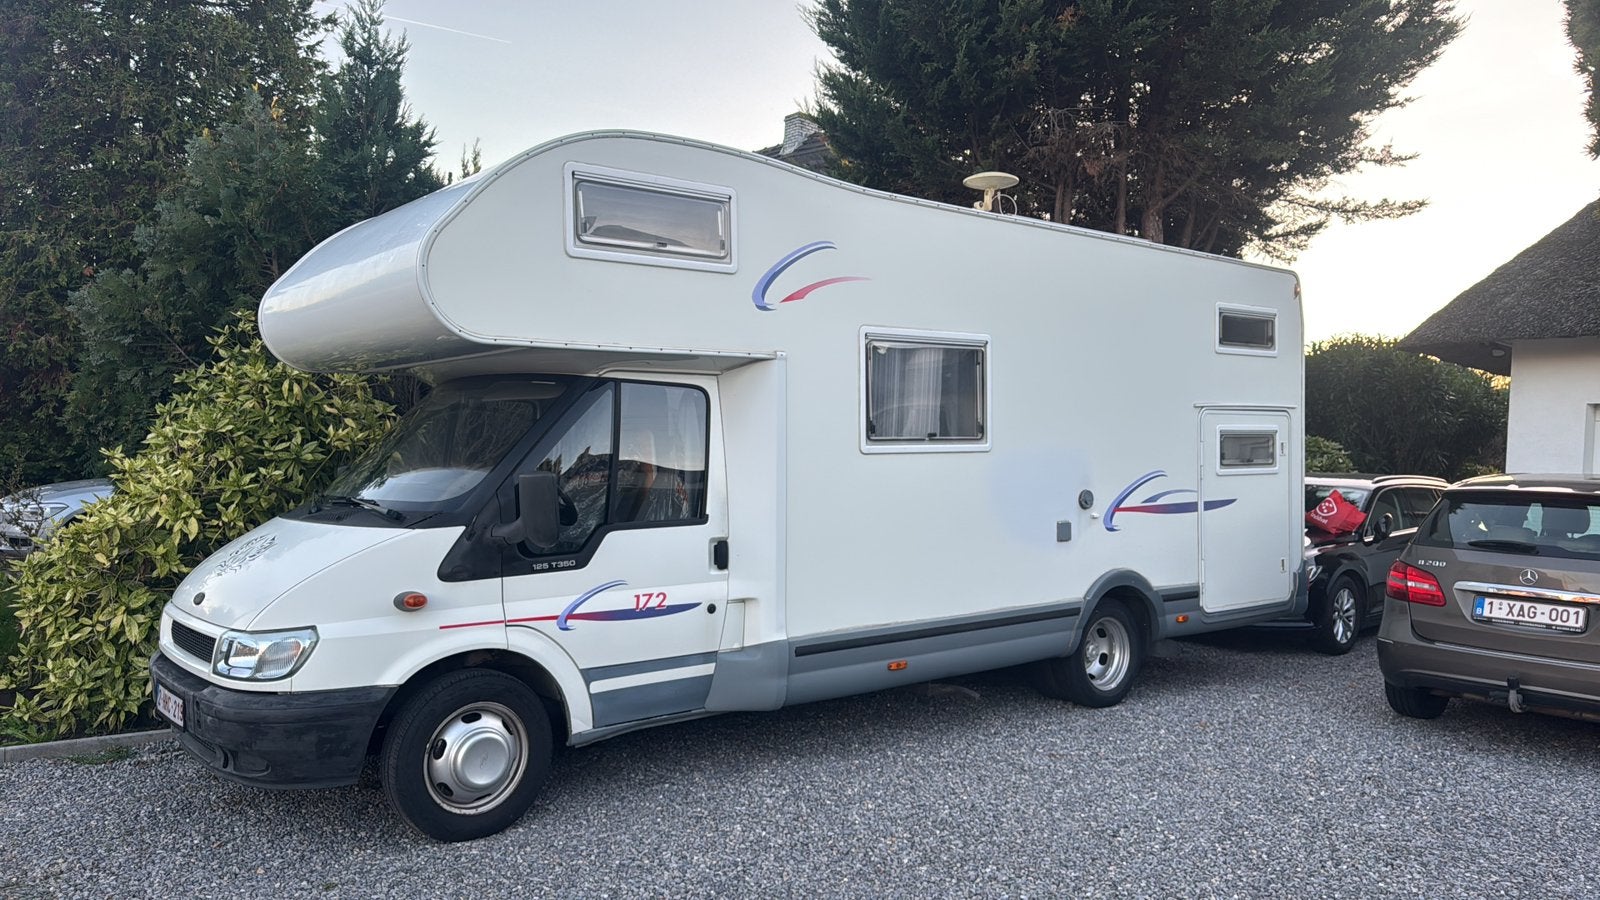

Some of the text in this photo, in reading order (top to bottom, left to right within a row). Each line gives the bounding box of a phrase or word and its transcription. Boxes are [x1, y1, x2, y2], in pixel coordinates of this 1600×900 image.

[532, 559, 576, 571] 125 T350
[1425, 560, 1447, 568] 200
[634, 591, 667, 612] 172
